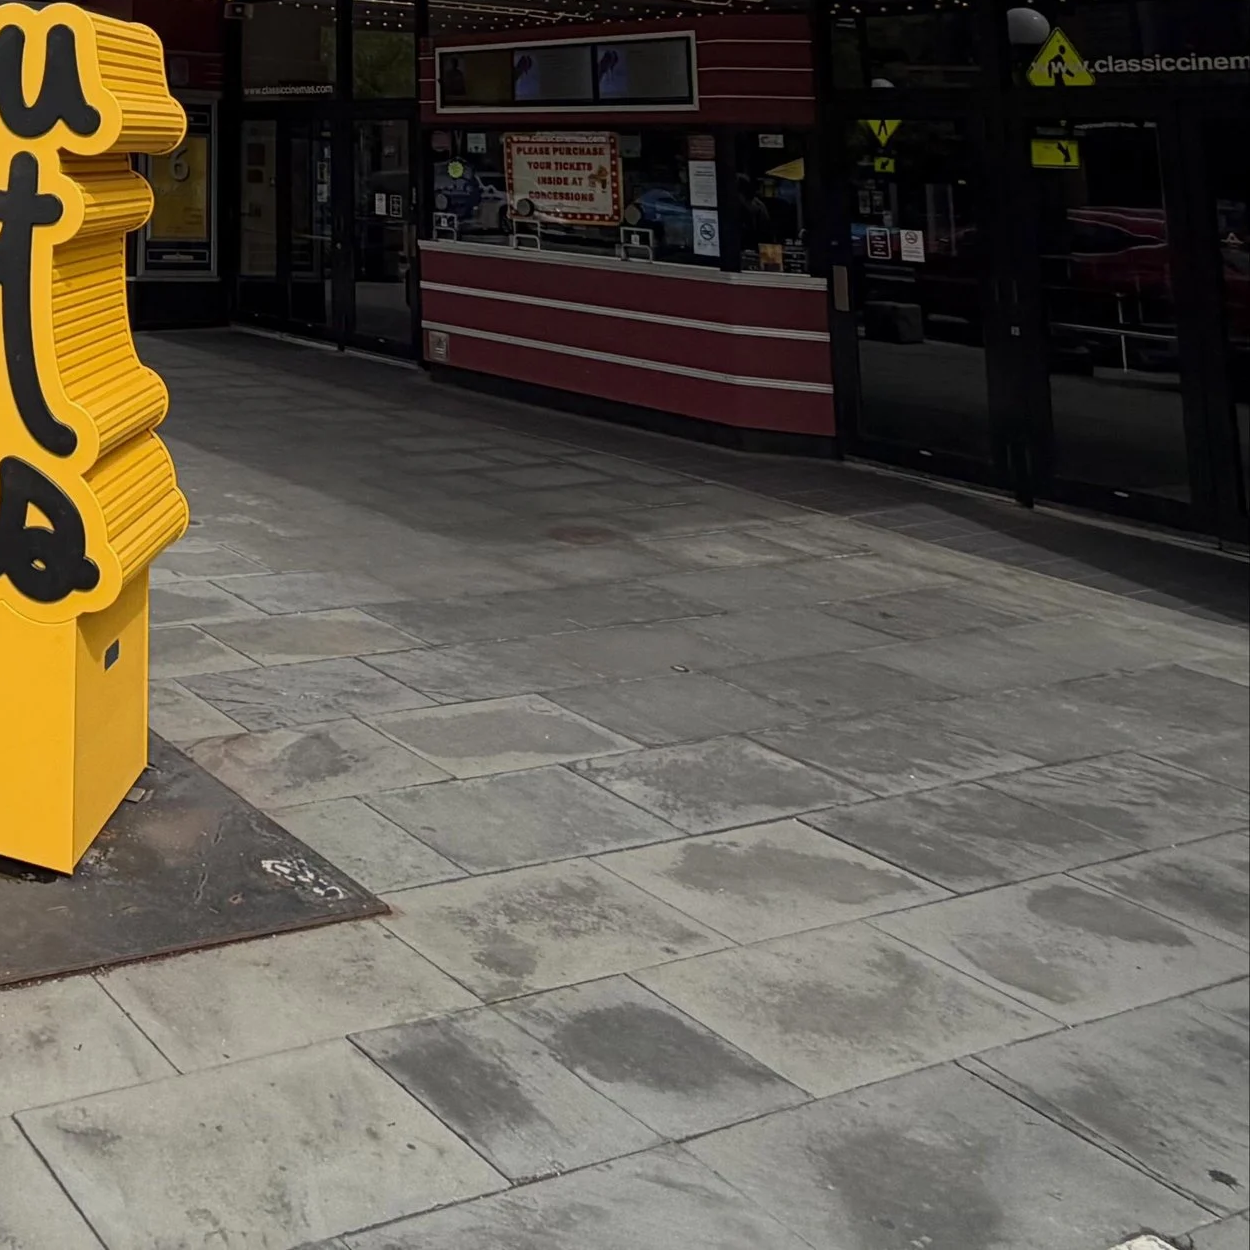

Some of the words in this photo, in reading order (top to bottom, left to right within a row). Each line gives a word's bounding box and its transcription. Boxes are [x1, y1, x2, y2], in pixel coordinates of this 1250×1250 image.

[516, 147, 550, 156] PLEASE
[553, 147, 606, 156] PURCHASE
[527, 161, 552, 170] YOUR
[555, 161, 594, 171] TICKETS
[537, 176, 570, 186] INSIDE
[572, 176, 584, 186] AT
[528, 191, 595, 202] CONCESSIONS
